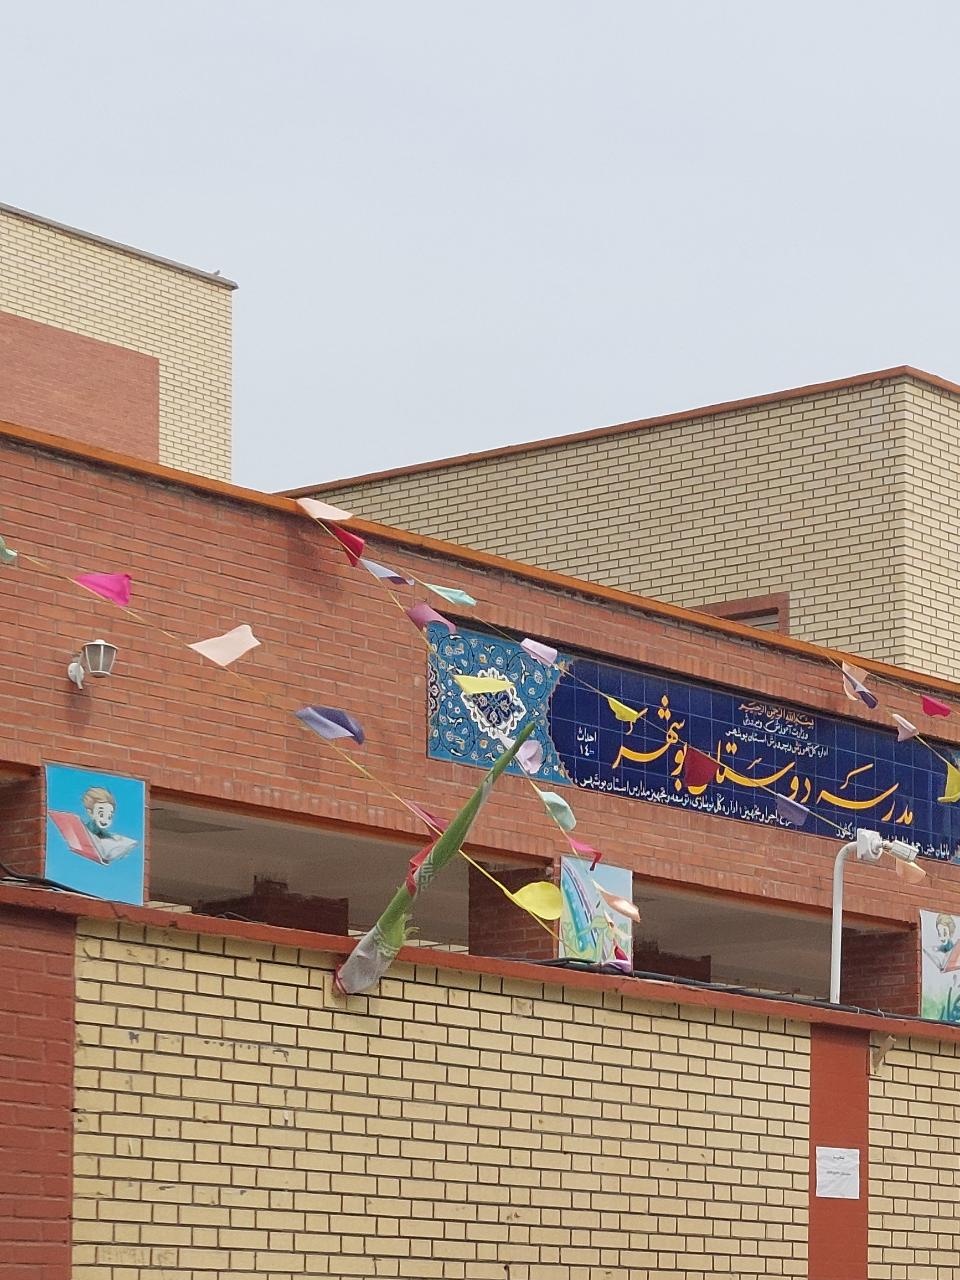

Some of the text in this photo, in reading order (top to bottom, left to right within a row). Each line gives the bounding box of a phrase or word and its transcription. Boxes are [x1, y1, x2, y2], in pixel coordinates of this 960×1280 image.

[576, 726, 597, 742] احداث
[791, 726, 809, 741] وزارت
[606, 776, 629, 792] استان
[816, 763, 914, 825] مدرسه
